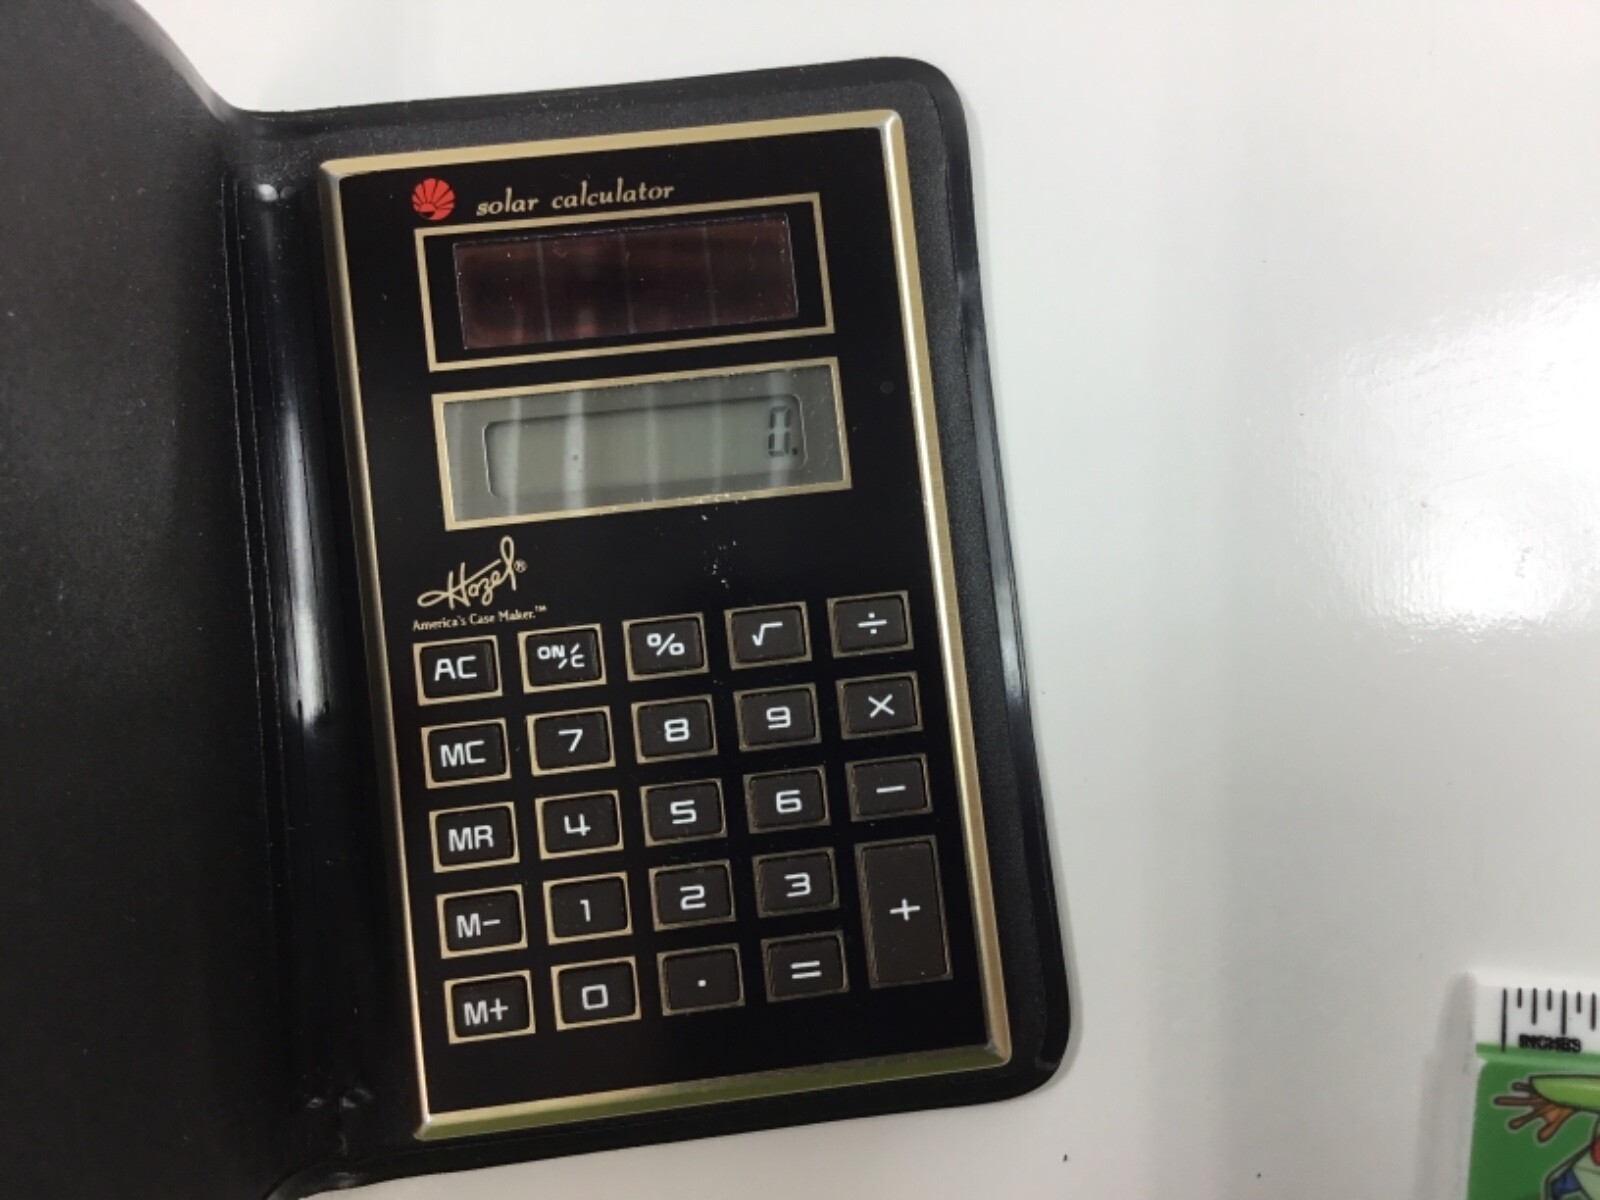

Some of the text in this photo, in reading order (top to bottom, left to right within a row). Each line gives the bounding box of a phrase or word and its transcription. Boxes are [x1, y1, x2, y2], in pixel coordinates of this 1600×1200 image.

[476, 177, 675, 217] solar calculator
[412, 615, 467, 632] America's
[469, 612, 495, 625] Case
[434, 655, 478, 682] AC
[663, 717, 690, 743] 8
[765, 705, 792, 730] 9
[440, 739, 486, 768] MC
[558, 728, 584, 753] 7
[669, 799, 697, 825] 5
[775, 789, 803, 814] 6
[448, 824, 494, 852] MR
[563, 813, 592, 837] 4
[679, 884, 707, 910] 2
[784, 872, 811, 898] 3
[579, 899, 591, 922] 1
[463, 998, 509, 1026] M+
[1519, 1033, 1581, 1054] INCHES
